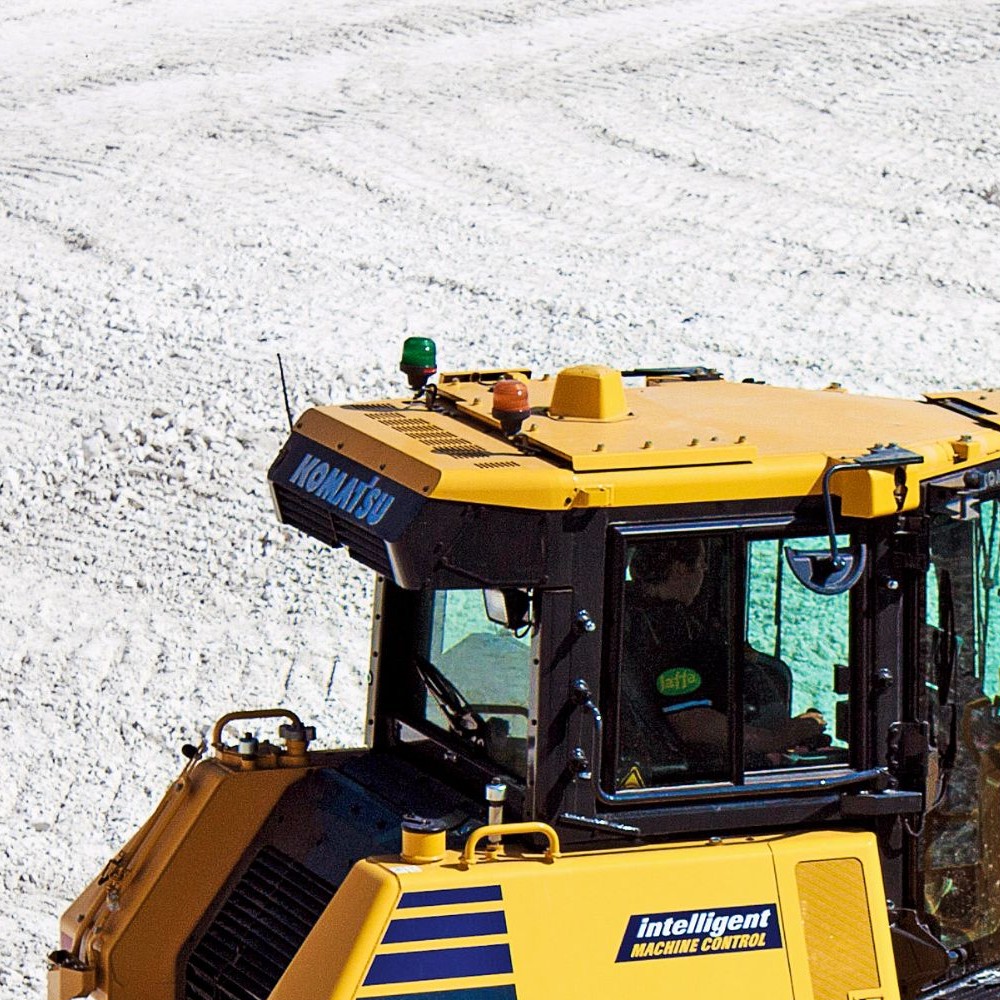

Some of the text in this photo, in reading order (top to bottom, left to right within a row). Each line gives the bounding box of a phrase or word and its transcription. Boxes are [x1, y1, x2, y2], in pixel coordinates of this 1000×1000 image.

[288, 453, 396, 525] KOMATSU
[637, 909, 771, 938] intelligent
[630, 932, 766, 958] MACHINE CONTROL
